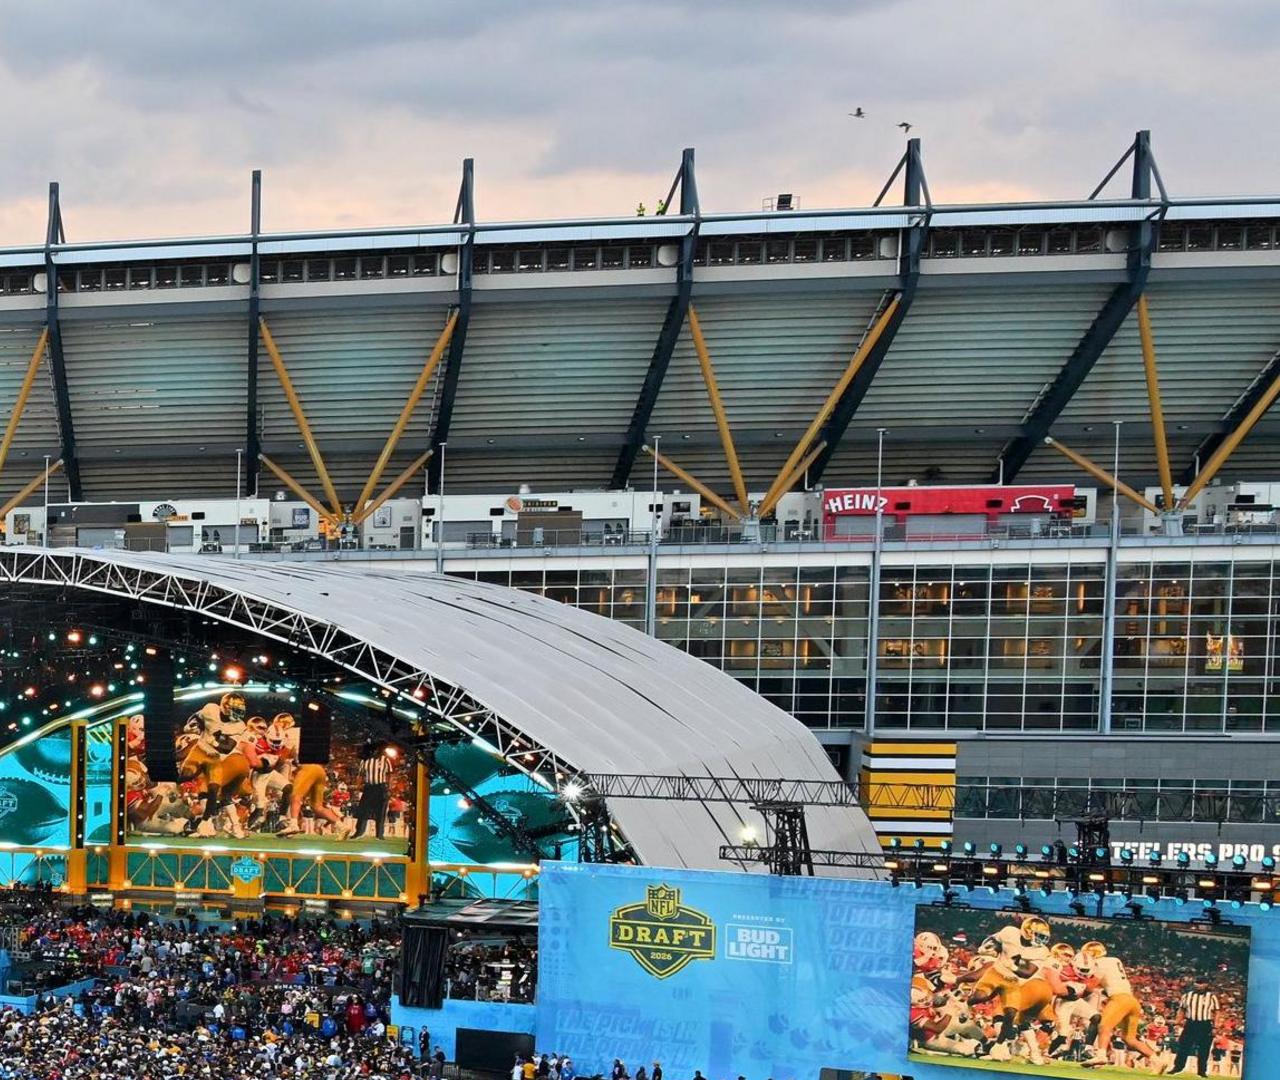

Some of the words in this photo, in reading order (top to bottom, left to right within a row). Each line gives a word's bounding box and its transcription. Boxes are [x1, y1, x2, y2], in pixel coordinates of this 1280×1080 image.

[828, 494, 888, 513] HEINZ
[1111, 842, 1212, 861] TEELERS
[1219, 844, 1265, 862] PRO
[651, 900, 674, 916] NFL
[618, 925, 706, 946] DRAFT
[738, 928, 781, 944] BUD
[650, 952, 672, 960] 2026
[729, 942, 788, 960] LIGHT
